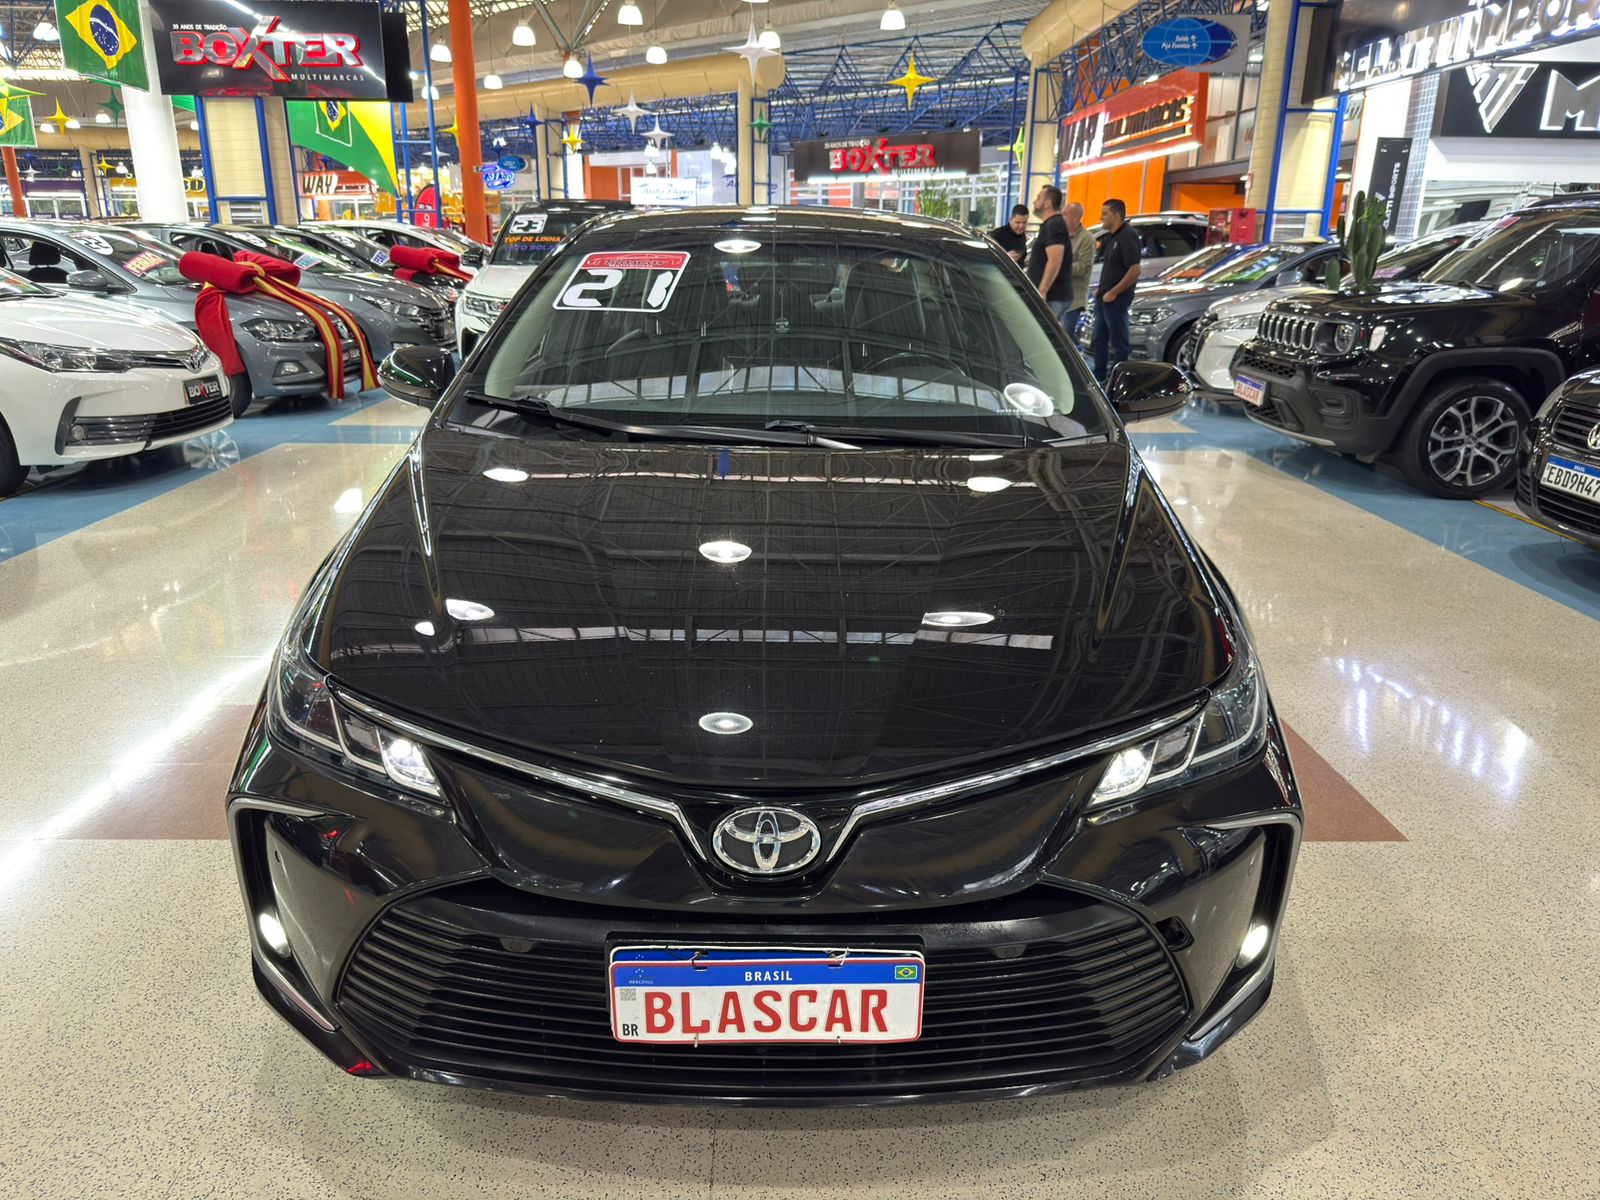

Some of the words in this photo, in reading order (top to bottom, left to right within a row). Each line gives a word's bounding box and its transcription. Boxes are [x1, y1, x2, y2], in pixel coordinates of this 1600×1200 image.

[195, 23, 202, 31] DE
[203, 23, 228, 31] TRADIÇÃO
[170, 15, 364, 83] BOXTER
[291, 73, 365, 82] MULTIMARCAS
[829, 138, 936, 175] BOXTER
[892, 167, 945, 175] MULTIMARCAS
[303, 175, 332, 194] WAY
[534, 235, 561, 243] LINHA
[562, 269, 674, 308] 21
[188, 381, 220, 400] BOXTER
[1545, 465, 1600, 499] EBD9H47
[745, 970, 793, 982] BRASIL
[644, 990, 888, 1034] BLASCAR
[622, 1023, 639, 1036] BR
